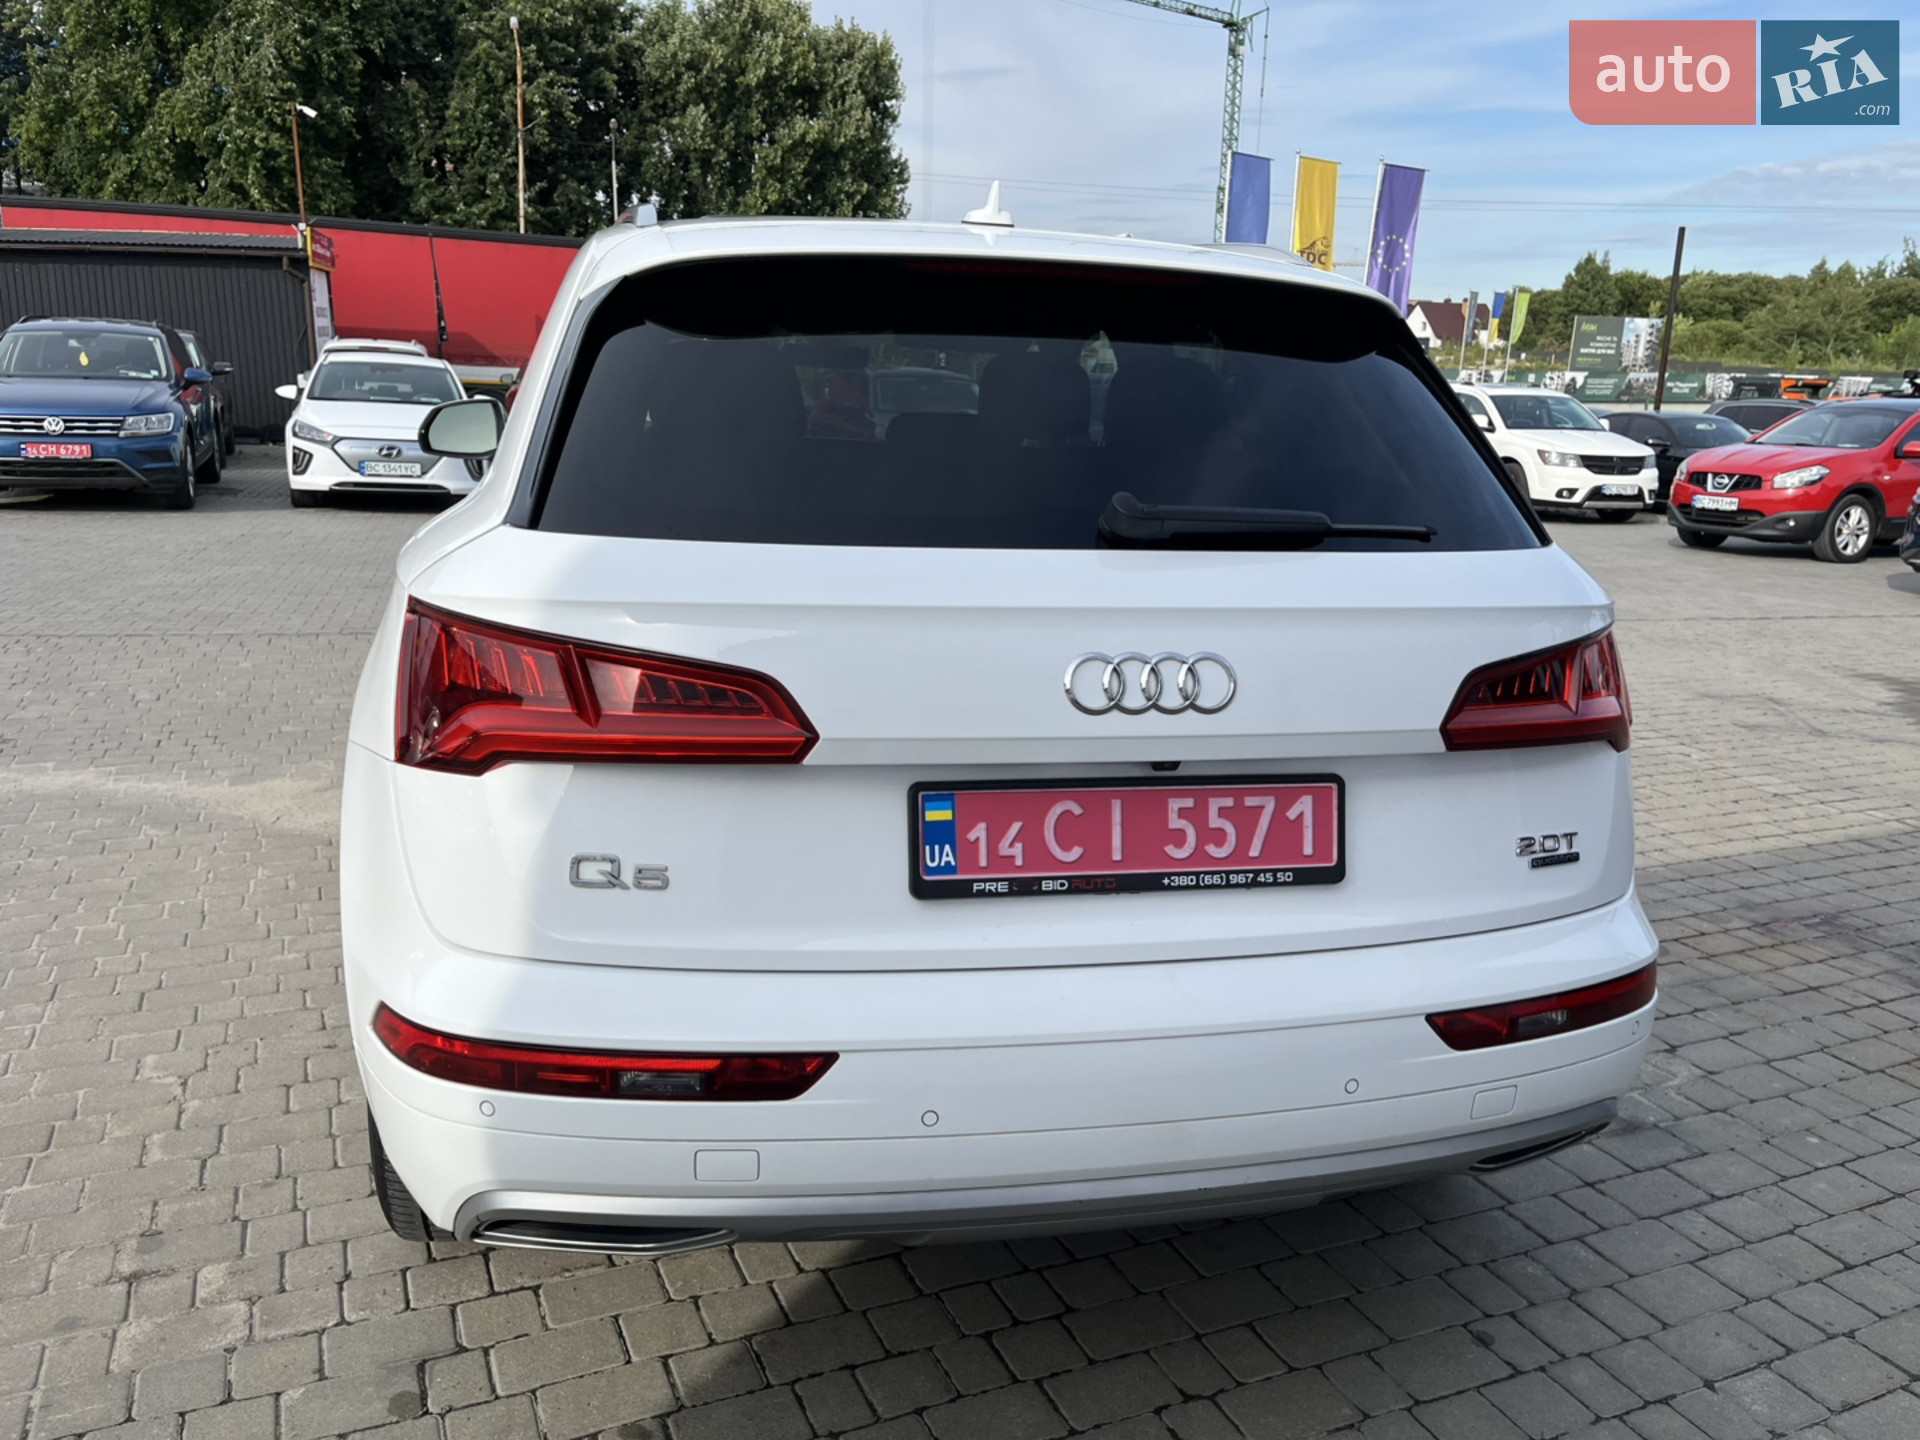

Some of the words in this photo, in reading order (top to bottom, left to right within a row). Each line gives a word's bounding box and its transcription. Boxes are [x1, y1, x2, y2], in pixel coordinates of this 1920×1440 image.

[27, 446, 38, 455] 14
[39, 444, 57, 455] CH
[60, 444, 88, 456] 6791
[366, 463, 380, 473] BC
[966, 821, 1024, 868] 14
[1044, 798, 1123, 863] CI
[1163, 795, 1315, 860] 5571
[924, 844, 956, 868] UA
[568, 851, 671, 892] Q5
[1161, 875, 1197, 886] +380
[1199, 873, 1226, 886] (66)
[1229, 873, 1254, 884] 967
[1256, 872, 1274, 883] 45
[1276, 871, 1293, 882] 50
[972, 880, 1009, 893] PRE
[1041, 879, 1069, 892] BID
[1071, 877, 1117, 890] AUTO
